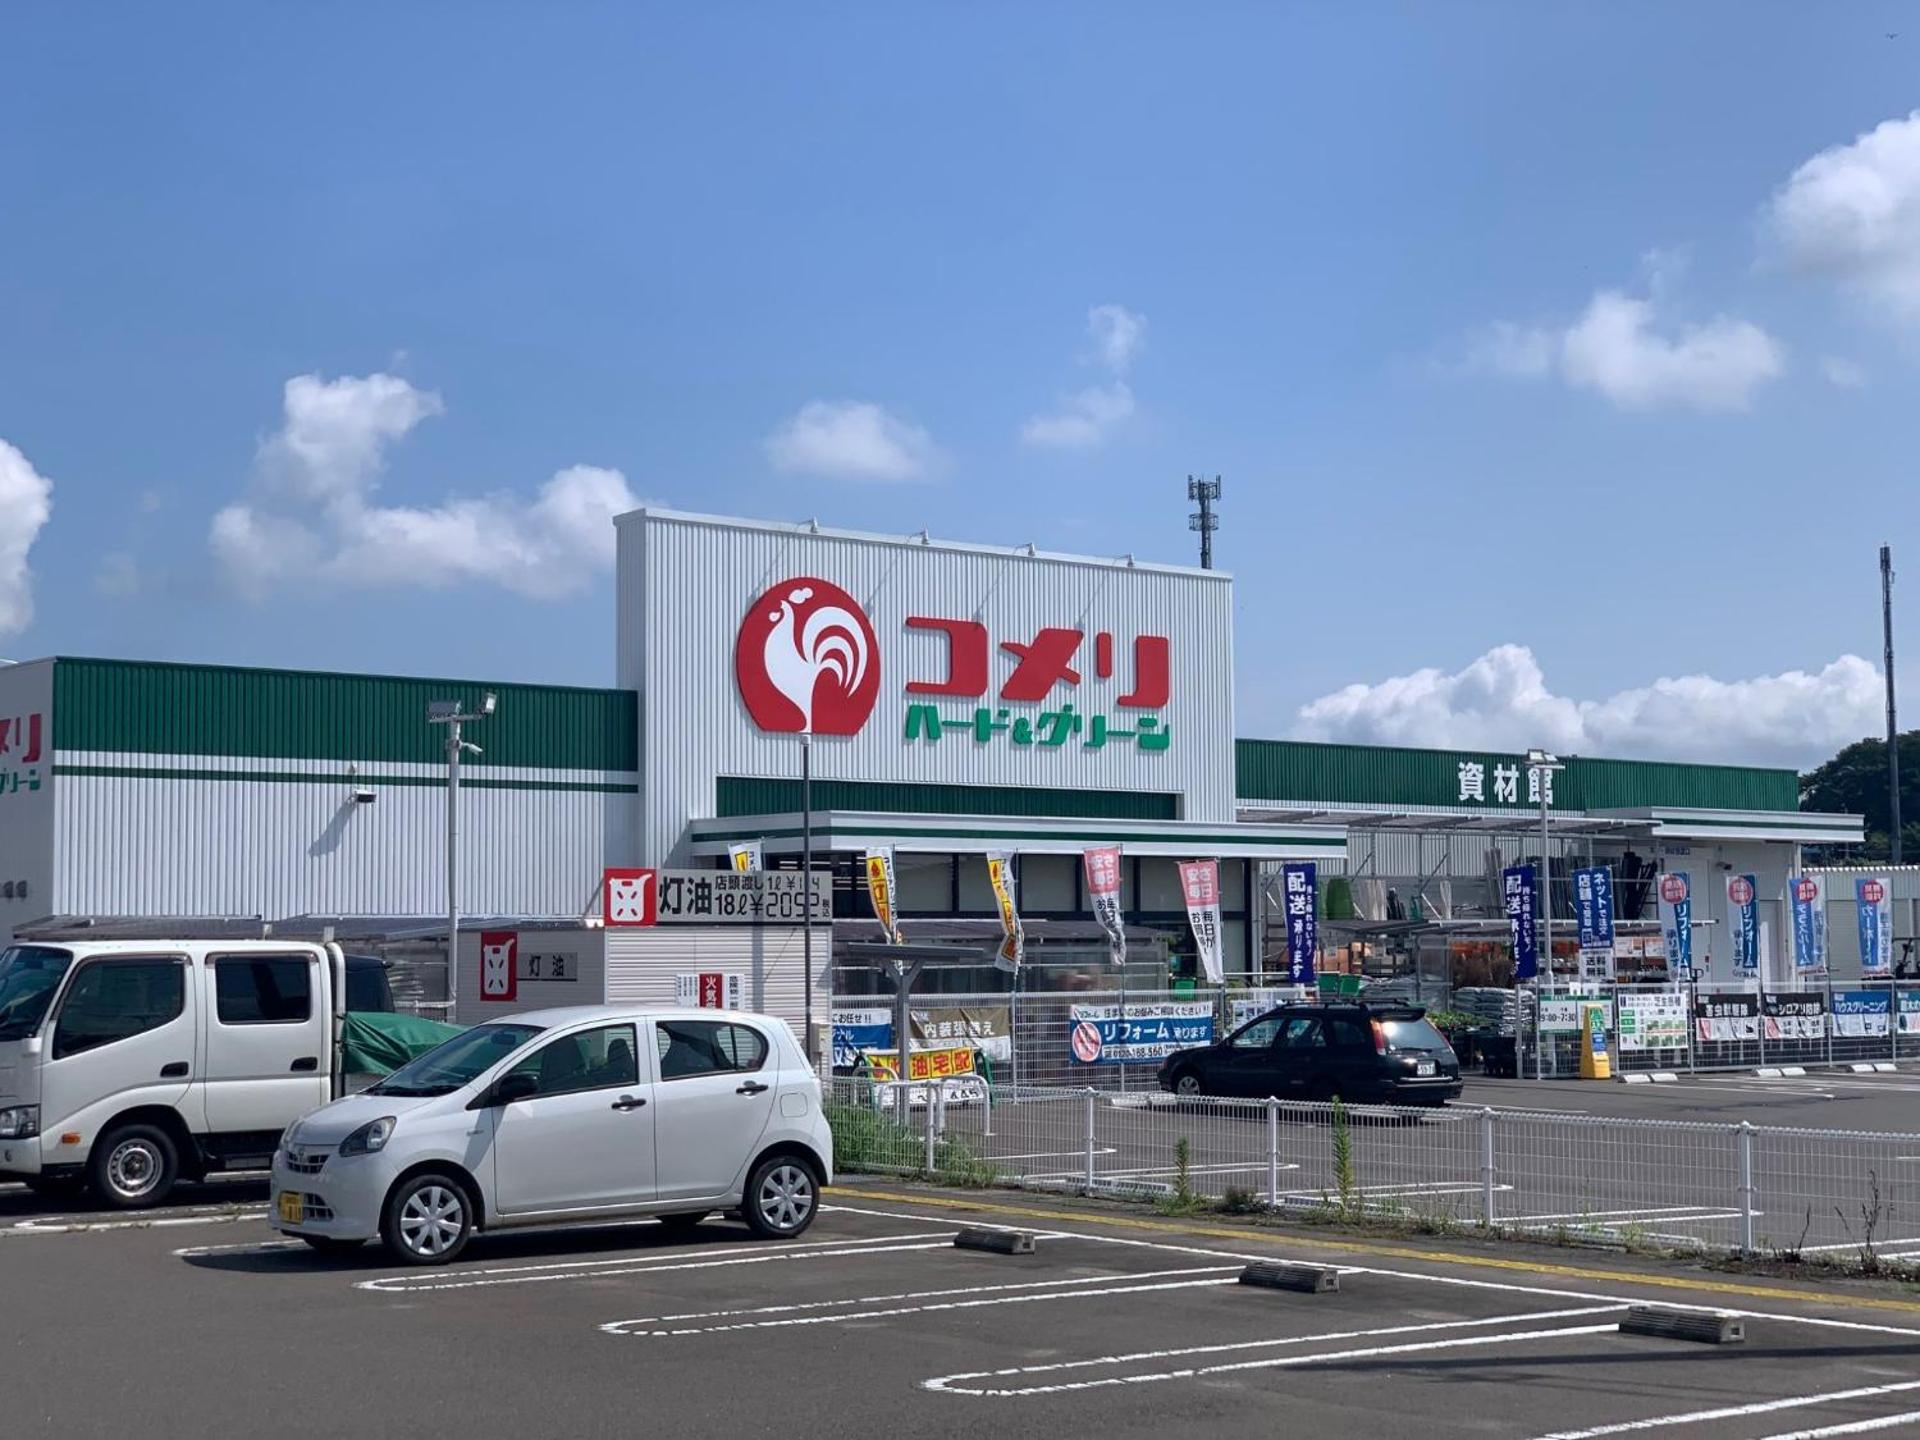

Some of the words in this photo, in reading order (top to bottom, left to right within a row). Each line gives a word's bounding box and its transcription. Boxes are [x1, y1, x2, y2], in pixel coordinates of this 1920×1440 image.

[905, 616, 1170, 708] コメリ
[1458, 761, 1553, 805] 資材館
[659, 876, 713, 915] 灯油
[528, 955, 564, 977] 灯油
